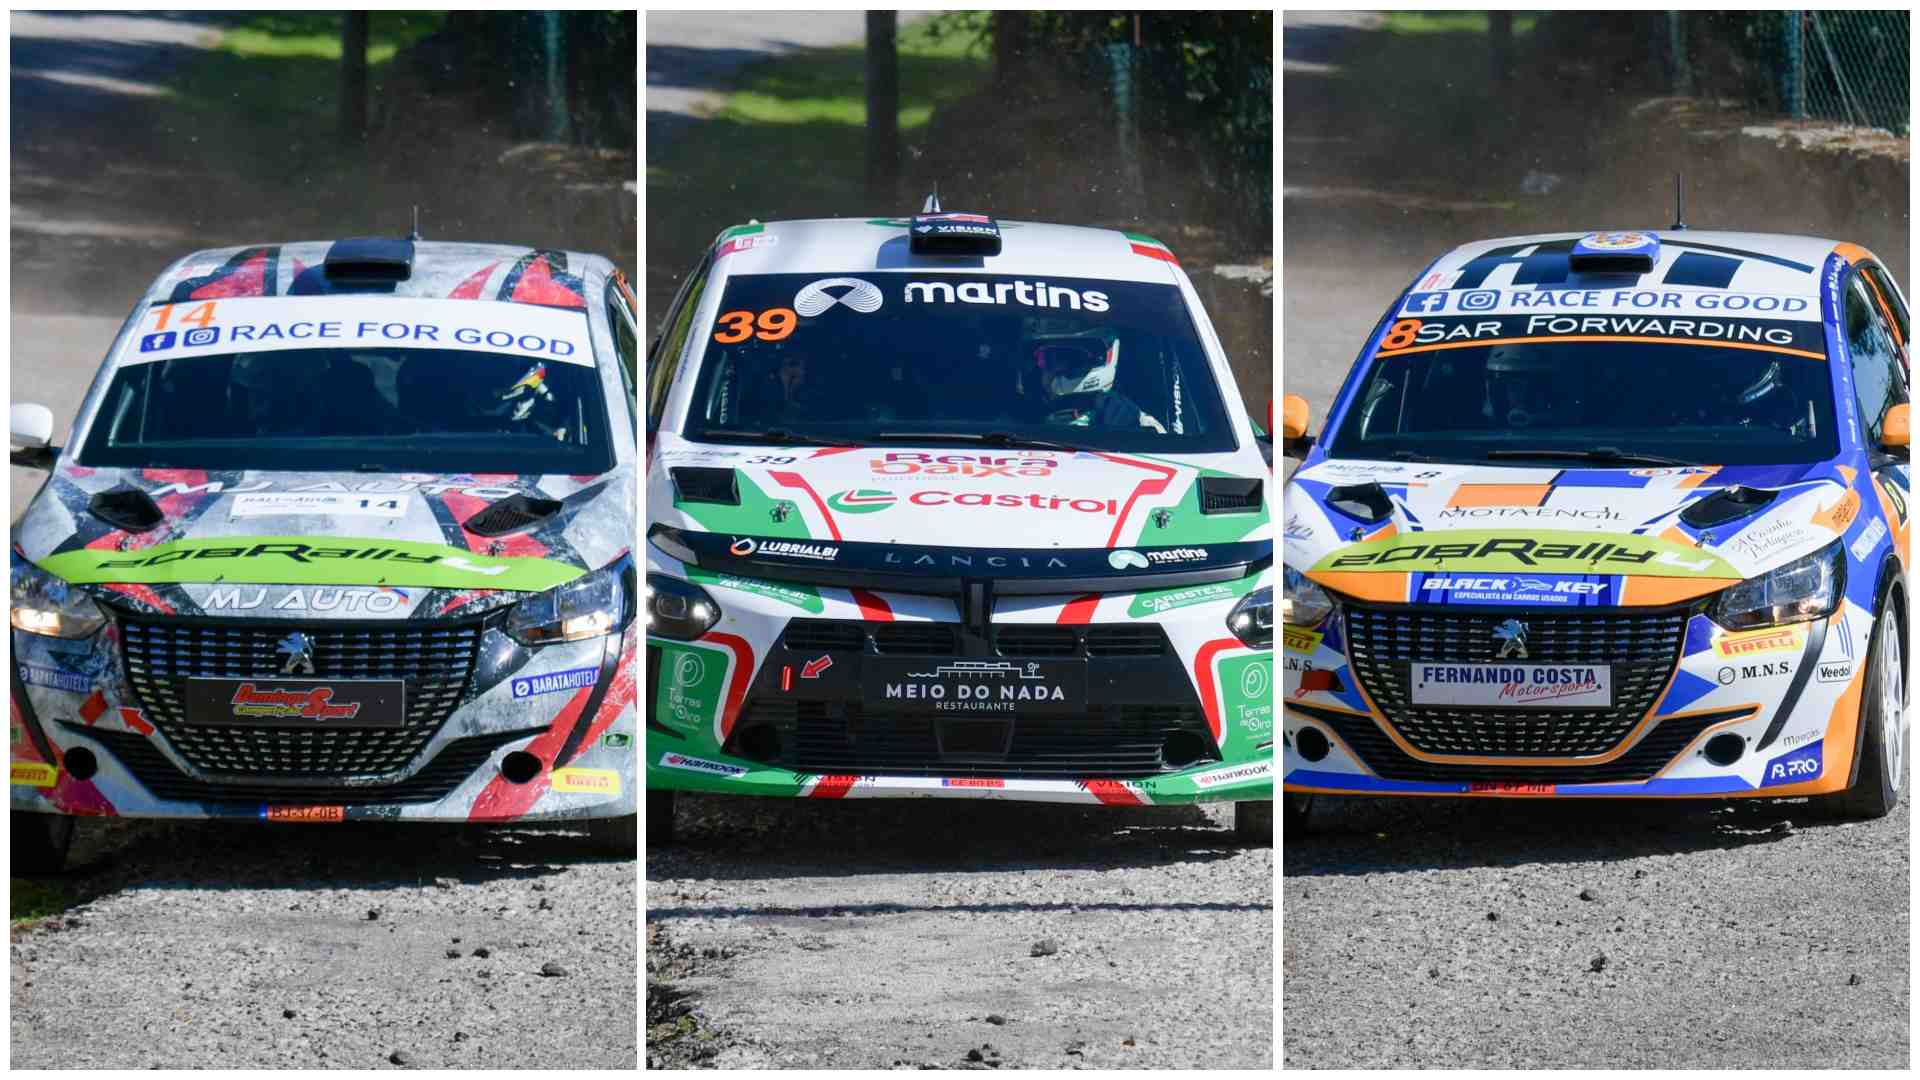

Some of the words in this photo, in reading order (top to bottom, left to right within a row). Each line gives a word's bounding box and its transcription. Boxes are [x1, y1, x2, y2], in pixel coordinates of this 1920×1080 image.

[904, 280, 1110, 312] martins
[1511, 291, 1600, 308] RACE
[1612, 291, 1683, 308] FOR
[1695, 295, 1808, 312] GOOD
[151, 302, 217, 330] 14
[713, 307, 797, 344] 39
[230, 321, 343, 341] RACE
[357, 322, 439, 341] FOR
[454, 327, 575, 356] GOOD
[1381, 318, 1420, 351] 8
[1415, 321, 1501, 343] SAR
[745, 455, 797, 465] 39
[869, 459, 1052, 479] baixa
[885, 452, 1059, 468] Beira
[359, 498, 399, 510] 14
[909, 490, 1117, 516] Castrol
[758, 541, 839, 557] LUBRIALBI
[1146, 548, 1209, 561] martins
[885, 551, 1067, 568] LANCIA
[1422, 578, 1510, 592] BLACK
[1553, 580, 1608, 595] KEY
[200, 588, 288, 610] MJ
[292, 587, 400, 613] AUTO
[1720, 631, 1795, 655] PIRELLI
[1423, 666, 1546, 684] FERNANDO
[1552, 667, 1597, 685] COSTA
[1741, 661, 1793, 680] M.N.S.
[1820, 665, 1851, 678] Veedol
[885, 684, 945, 699] MEIO
[957, 685, 990, 699] DO
[999, 685, 1065, 700] NADA
[1498, 681, 1595, 700] Motorsport
[935, 701, 1015, 711] RESTAURANTE
[1787, 758, 1818, 777] PRO
